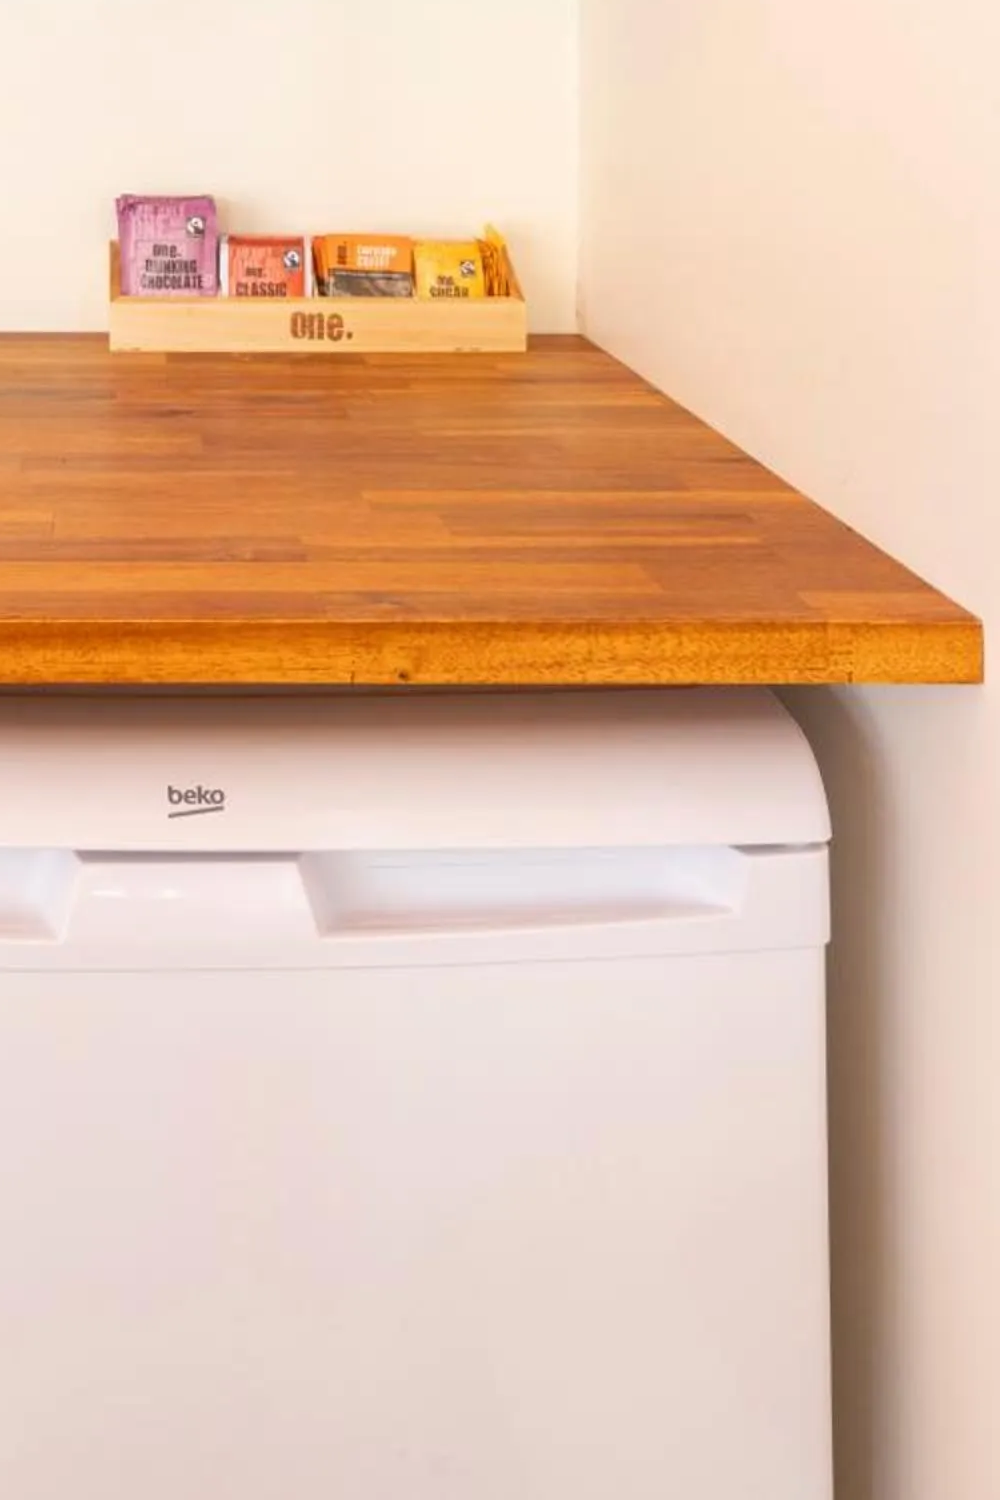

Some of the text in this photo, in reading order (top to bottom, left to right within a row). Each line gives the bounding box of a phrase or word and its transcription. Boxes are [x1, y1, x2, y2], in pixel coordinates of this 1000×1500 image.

[141, 274, 204, 290] CHOCOLATE
[236, 281, 287, 297] CLASSIC
[290, 311, 354, 342] one.
[167, 784, 225, 805] beko
